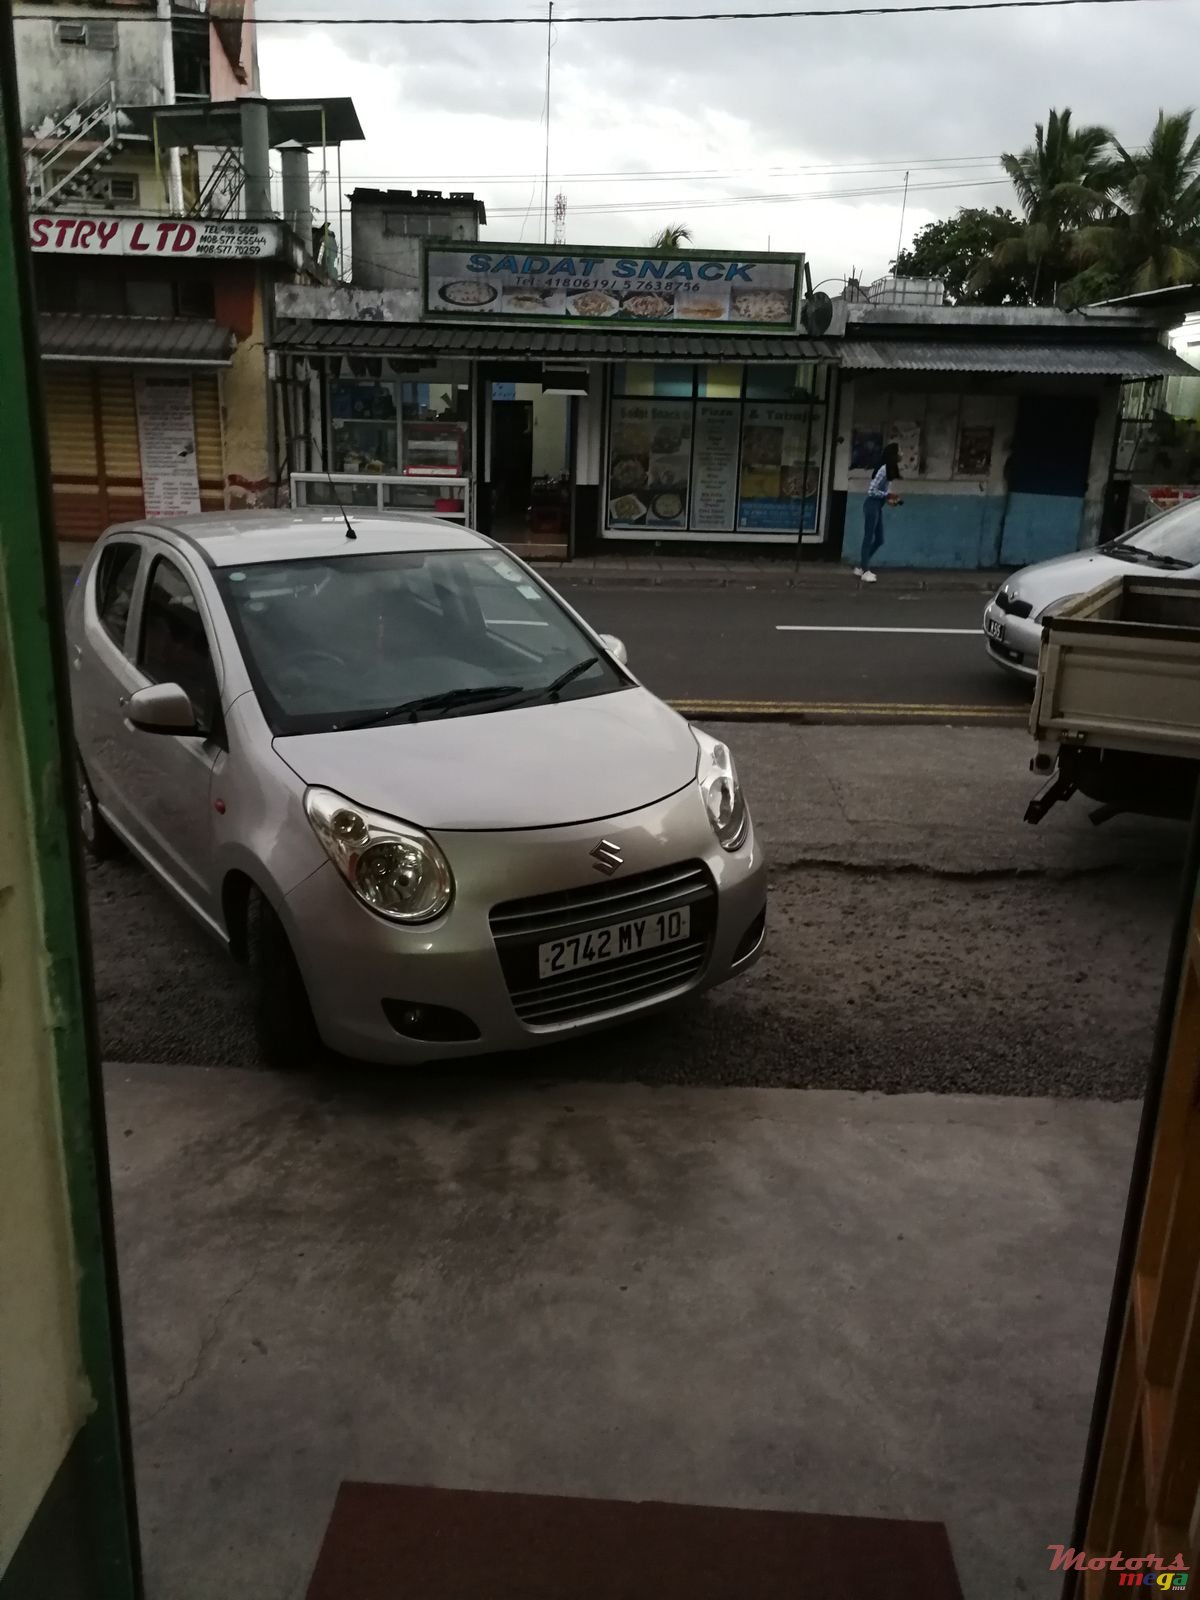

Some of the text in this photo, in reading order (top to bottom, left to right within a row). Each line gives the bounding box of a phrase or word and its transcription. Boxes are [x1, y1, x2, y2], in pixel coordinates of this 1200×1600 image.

[30, 218, 197, 252] STRY LTD
[466, 253, 758, 283] SADAT SNACK
[766, 409, 821, 424] Tabaje
[551, 911, 682, 971] 2742 MY 10
